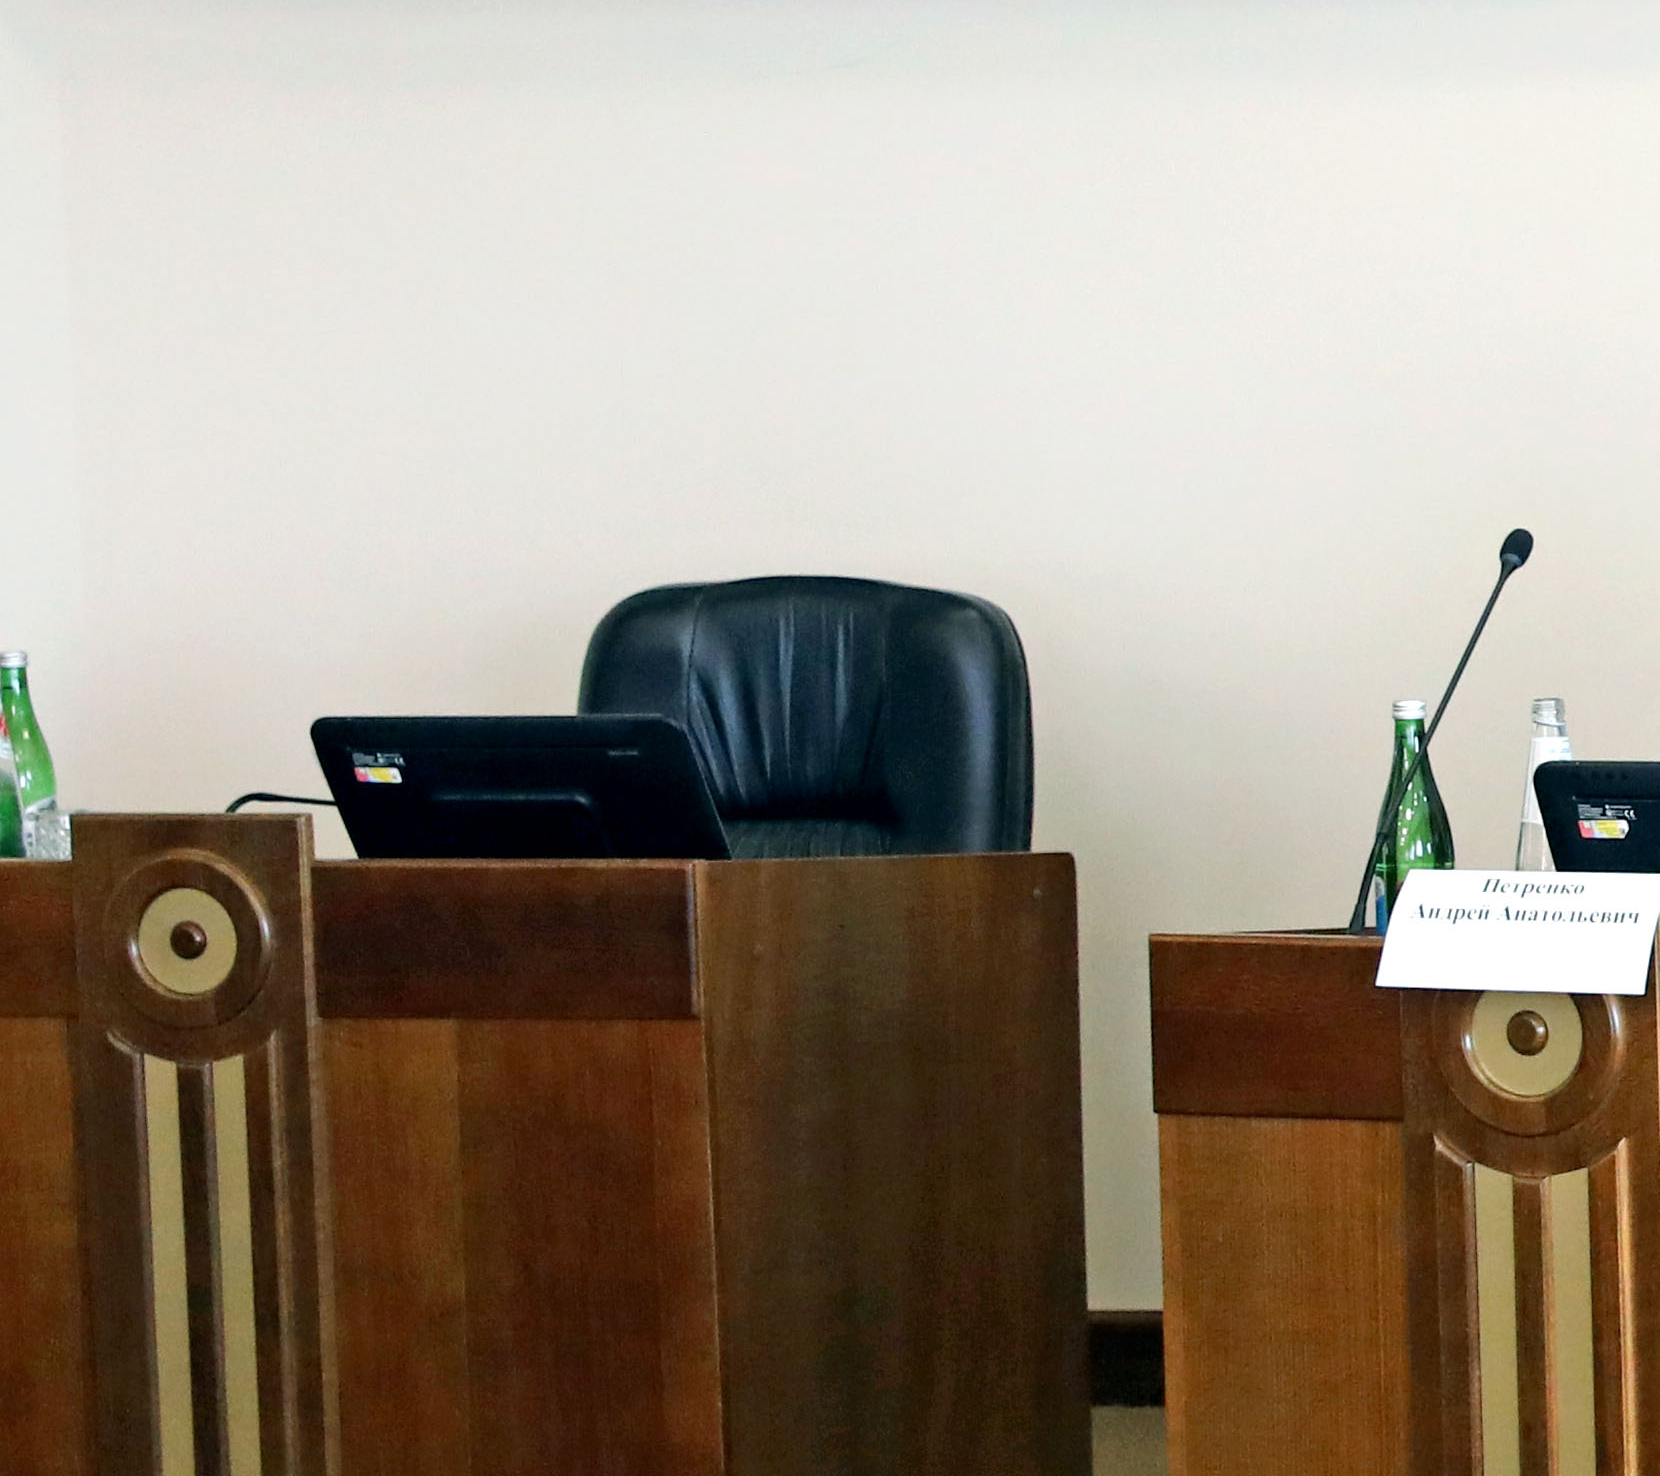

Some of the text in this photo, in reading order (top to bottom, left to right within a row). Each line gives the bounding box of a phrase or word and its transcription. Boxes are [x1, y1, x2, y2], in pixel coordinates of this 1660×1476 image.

[1482, 878, 1585, 899] Петренко
[1411, 903, 1640, 925] Андрей Анатольевич
